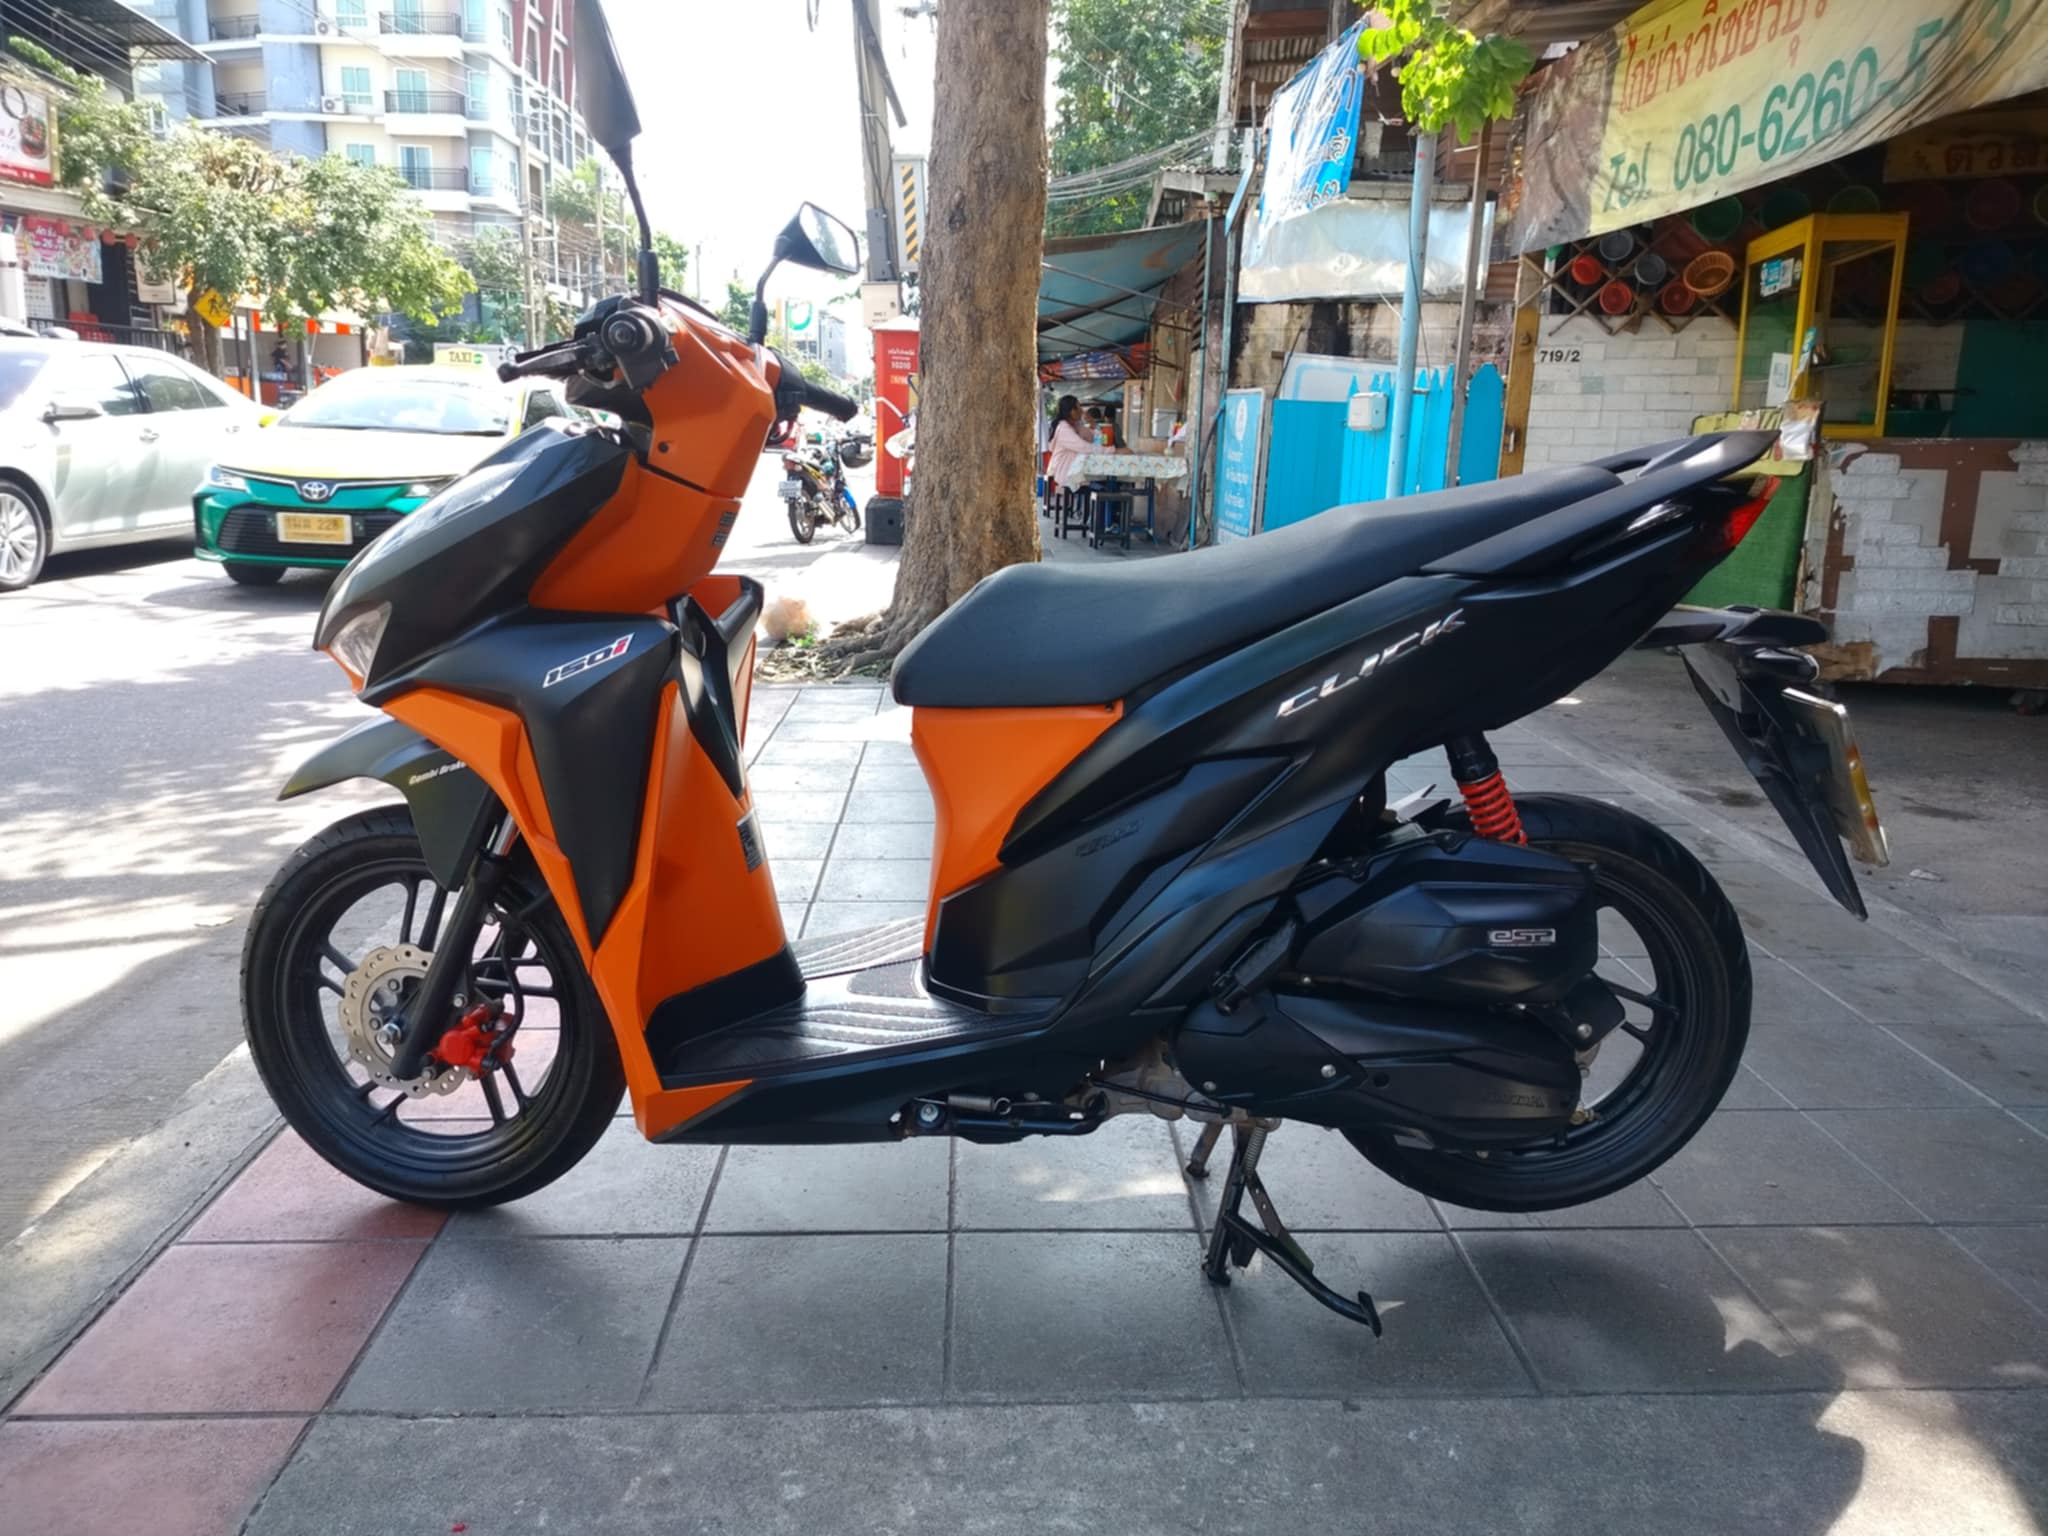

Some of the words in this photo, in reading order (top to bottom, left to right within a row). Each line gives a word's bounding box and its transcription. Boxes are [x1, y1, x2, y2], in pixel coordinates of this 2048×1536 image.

[449, 351, 472, 363] TAXI
[1540, 350, 1580, 362] 719/2
[543, 633, 634, 688] 150i
[1276, 608, 1465, 718] CLICK
